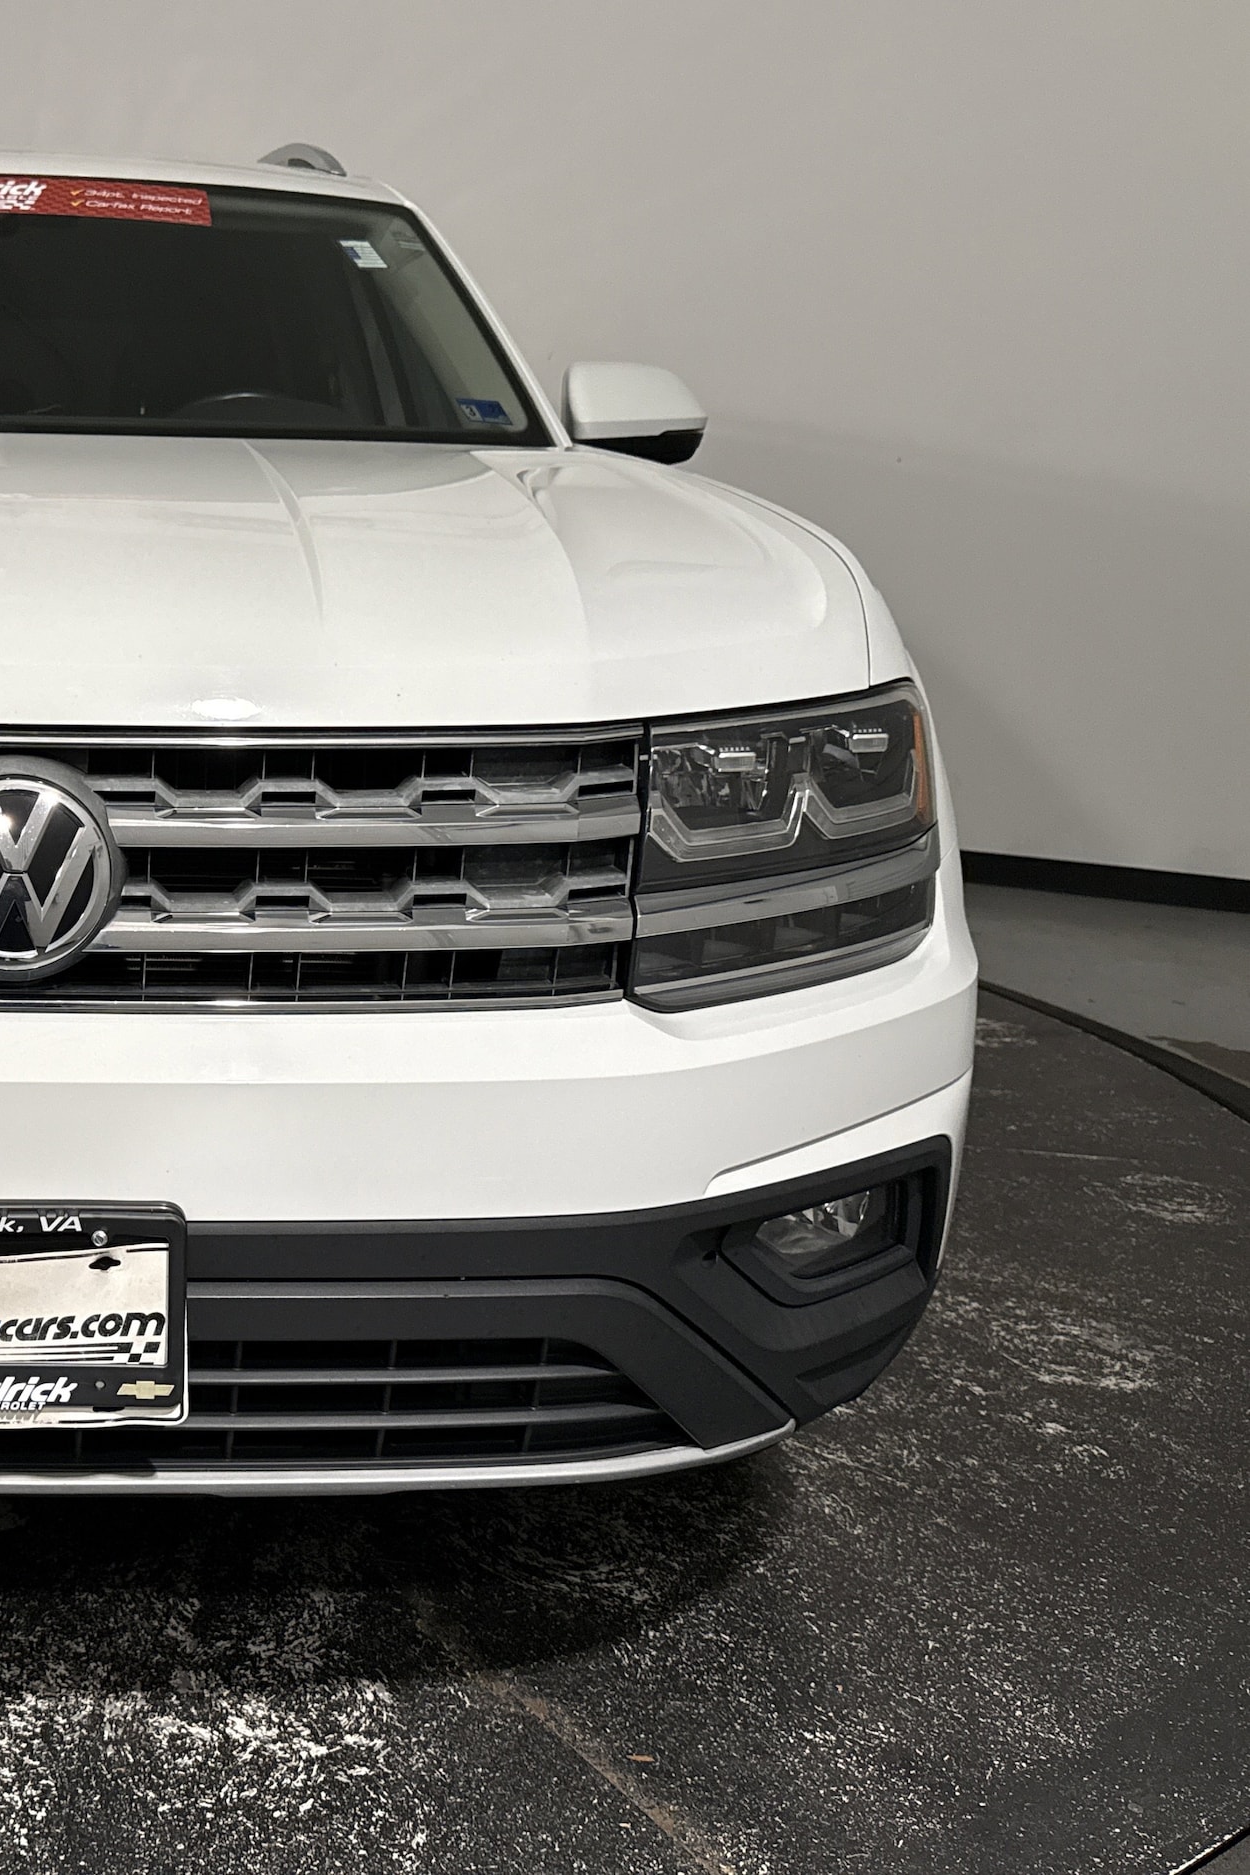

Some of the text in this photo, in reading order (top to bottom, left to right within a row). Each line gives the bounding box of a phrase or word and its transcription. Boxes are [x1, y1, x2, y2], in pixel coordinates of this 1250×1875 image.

[85, 199, 193, 215] Carfax Report
[131, 192, 204, 206] Inspected
[39, 1216, 83, 1233] VA
